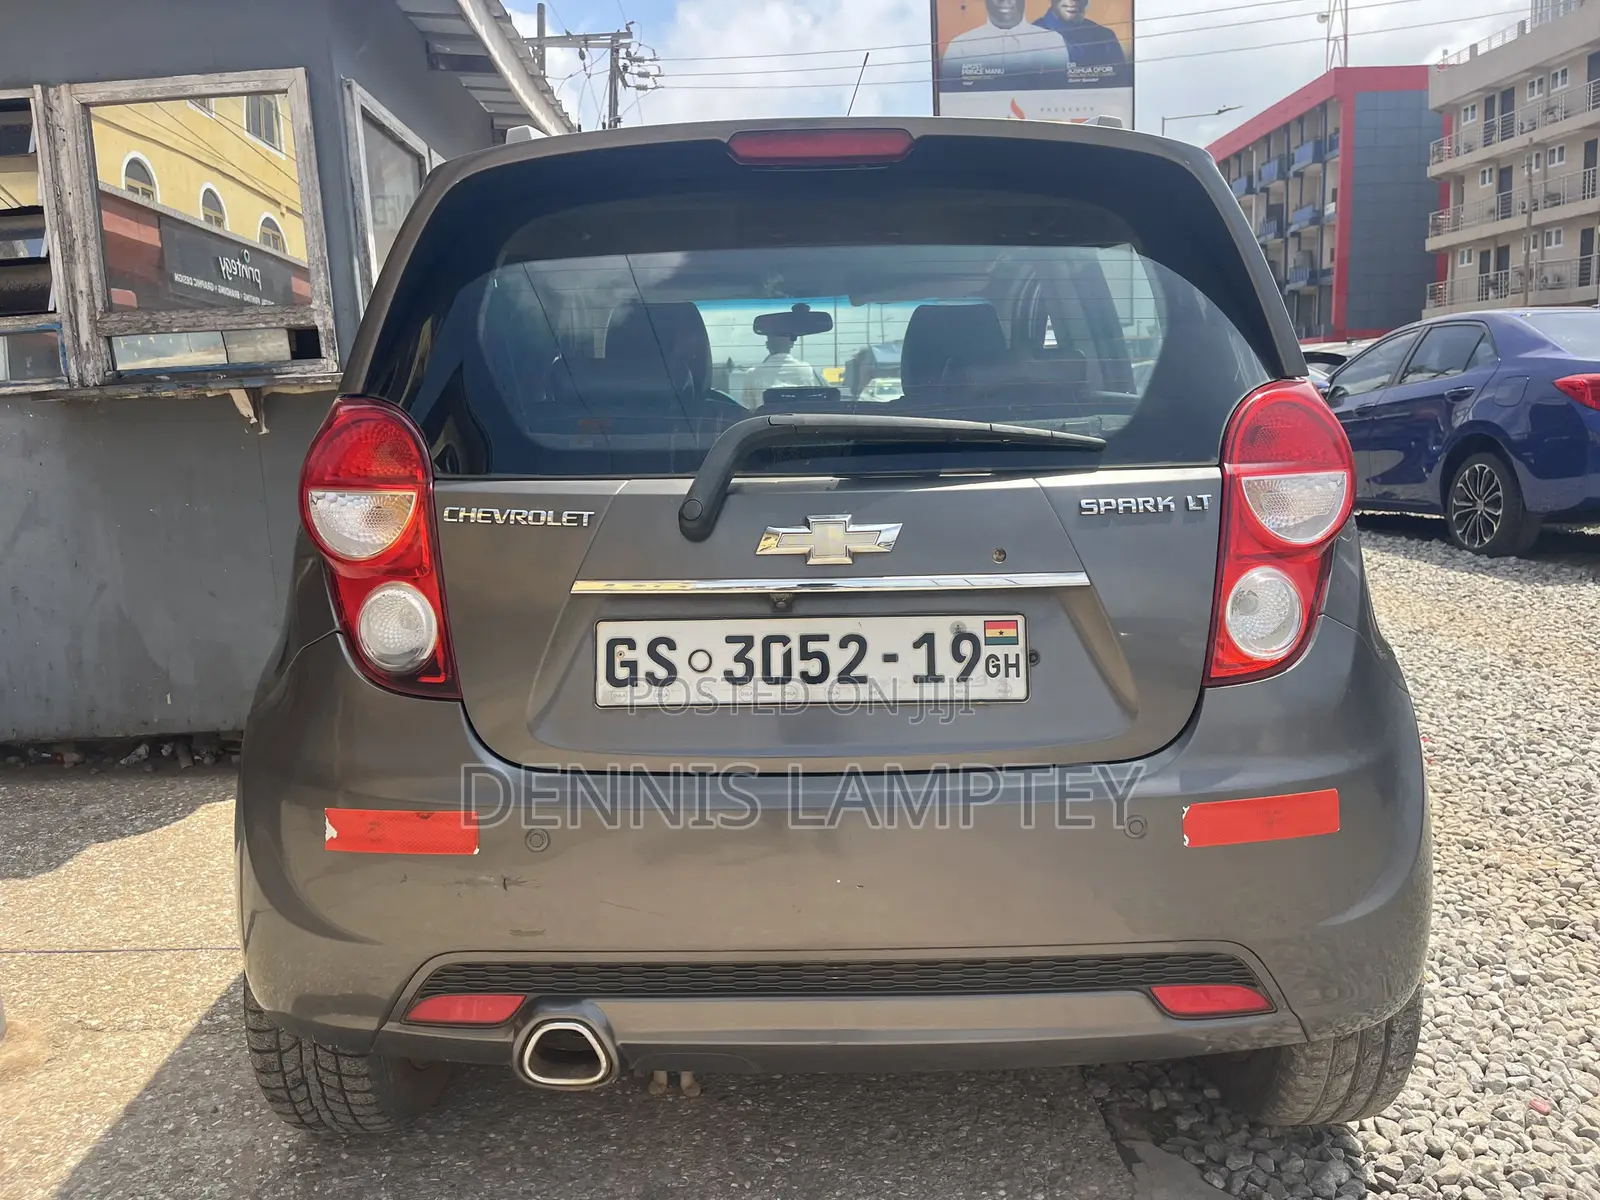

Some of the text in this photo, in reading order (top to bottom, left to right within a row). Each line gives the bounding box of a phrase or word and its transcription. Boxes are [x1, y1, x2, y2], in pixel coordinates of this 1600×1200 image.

[1080, 493, 1212, 515] SPARK LT
[443, 506, 595, 527] CHEVROLET
[605, 636, 678, 688] GS
[985, 652, 1021, 679] GH
